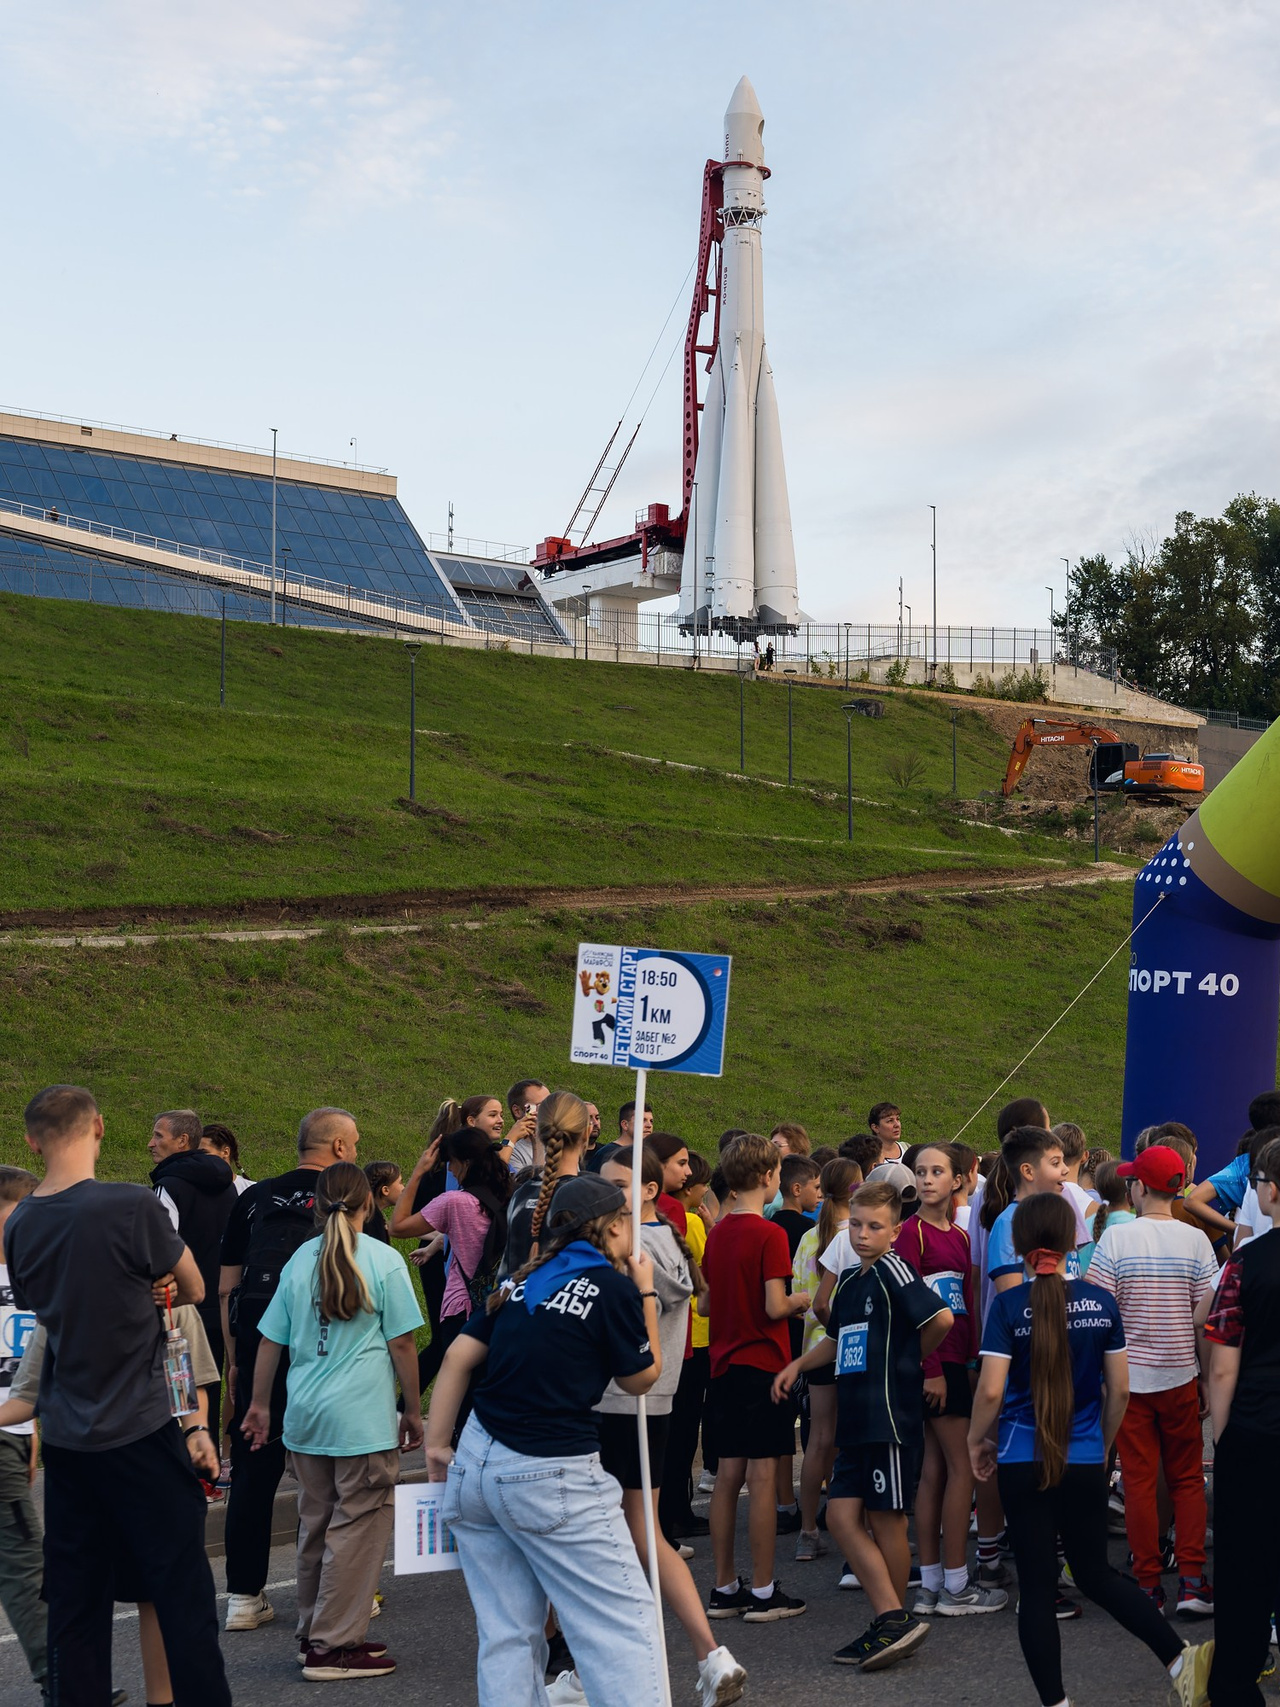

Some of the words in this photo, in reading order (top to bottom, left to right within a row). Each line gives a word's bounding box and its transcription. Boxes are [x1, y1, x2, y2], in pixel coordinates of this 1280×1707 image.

[1040, 735, 1065, 743] HITACHI
[1181, 767, 1202, 776] HITACHI
[618, 946, 639, 994] СТАРТ
[642, 969, 678, 988] 18:50
[1129, 968, 1192, 995] ПОРТ
[1198, 972, 1240, 997] 40
[640, 995, 649, 1022] 1
[650, 1008, 671, 1024] КМ
[635, 1030, 661, 1043] ЗАБЕГ
[661, 1032, 677, 1045] №2
[573, 1050, 598, 1059] СПОРТ
[634, 1042, 656, 1055] 2013
[1073, 1318, 1112, 1329] ОБЛАСТЬ
[844, 1345, 864, 1367] 3632
[872, 1468, 887, 1494] 9
